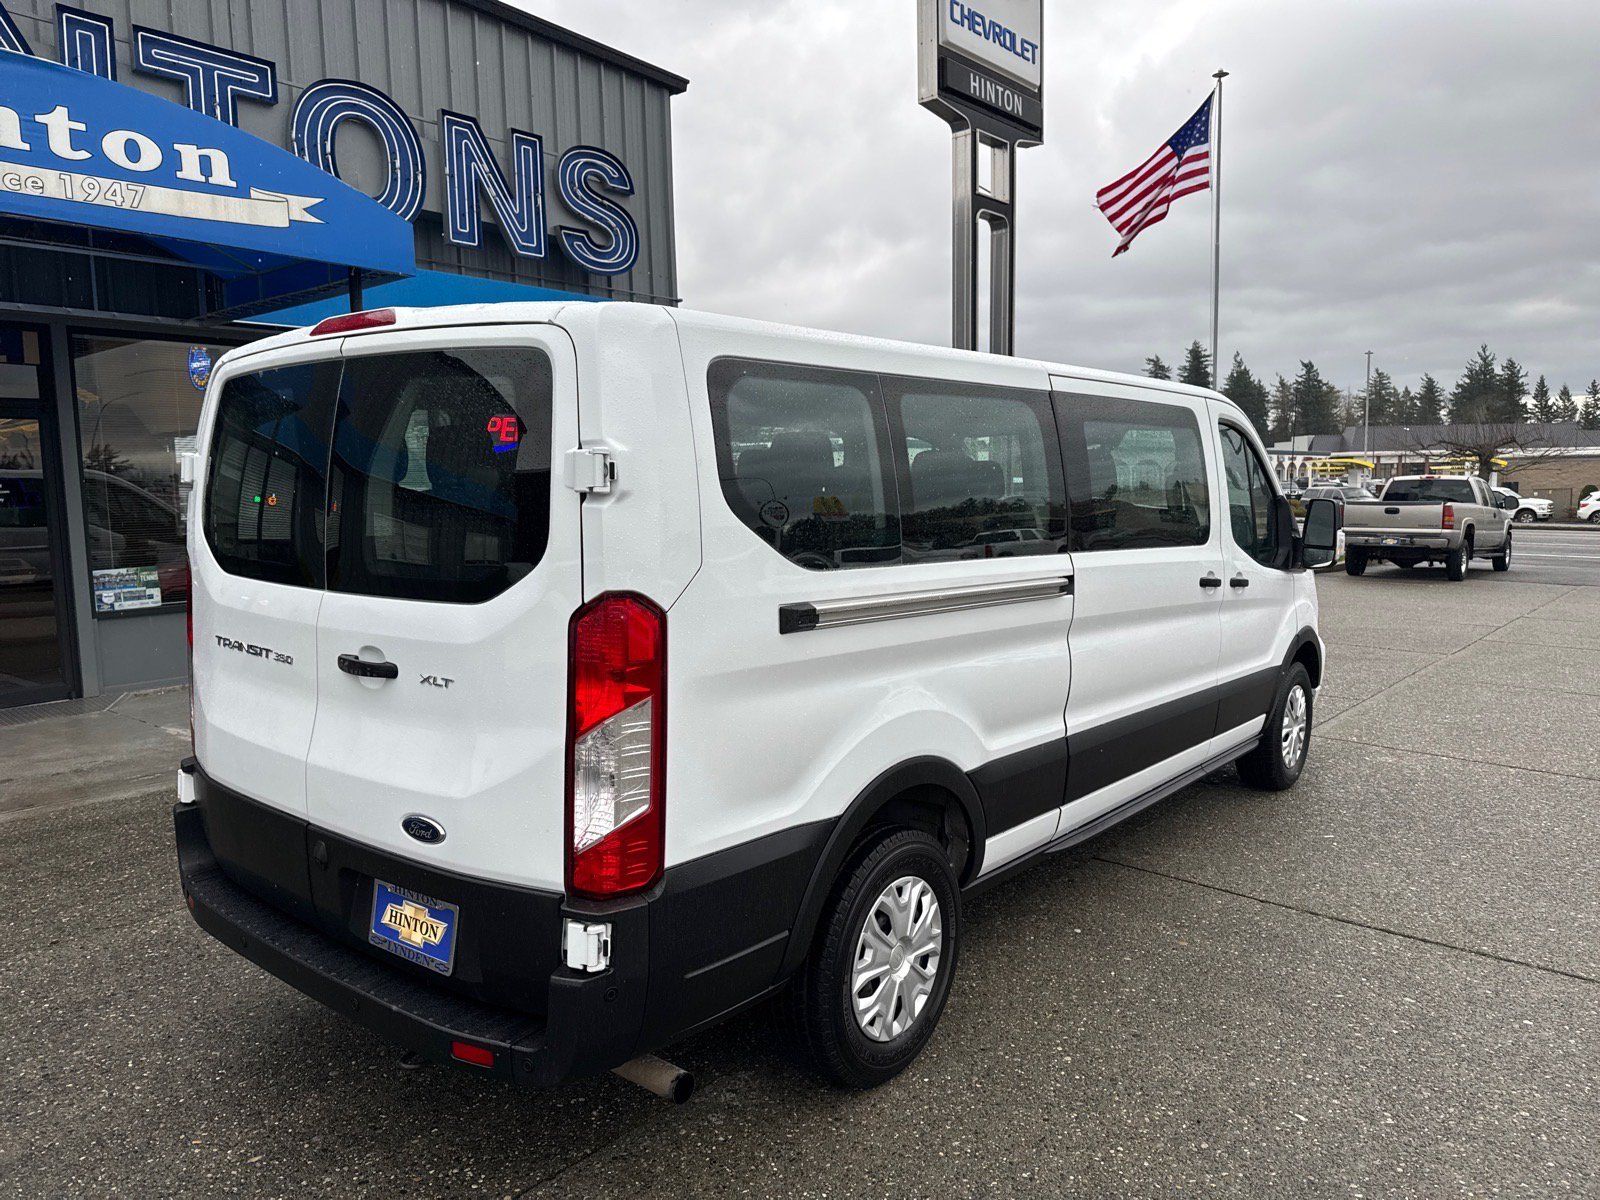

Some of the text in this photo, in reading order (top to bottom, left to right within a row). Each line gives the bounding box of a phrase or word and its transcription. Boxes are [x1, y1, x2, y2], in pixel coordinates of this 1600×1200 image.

[949, 0, 1039, 65] CHEVROLET
[969, 72, 1023, 117] HINTON
[59, 173, 146, 209] 1947
[215, 634, 294, 665] TRANSIT 350
[419, 673, 455, 689] XLT
[408, 820, 433, 839] Ford
[388, 908, 439, 941] HINTON
[387, 940, 430, 967] LYNDEN
